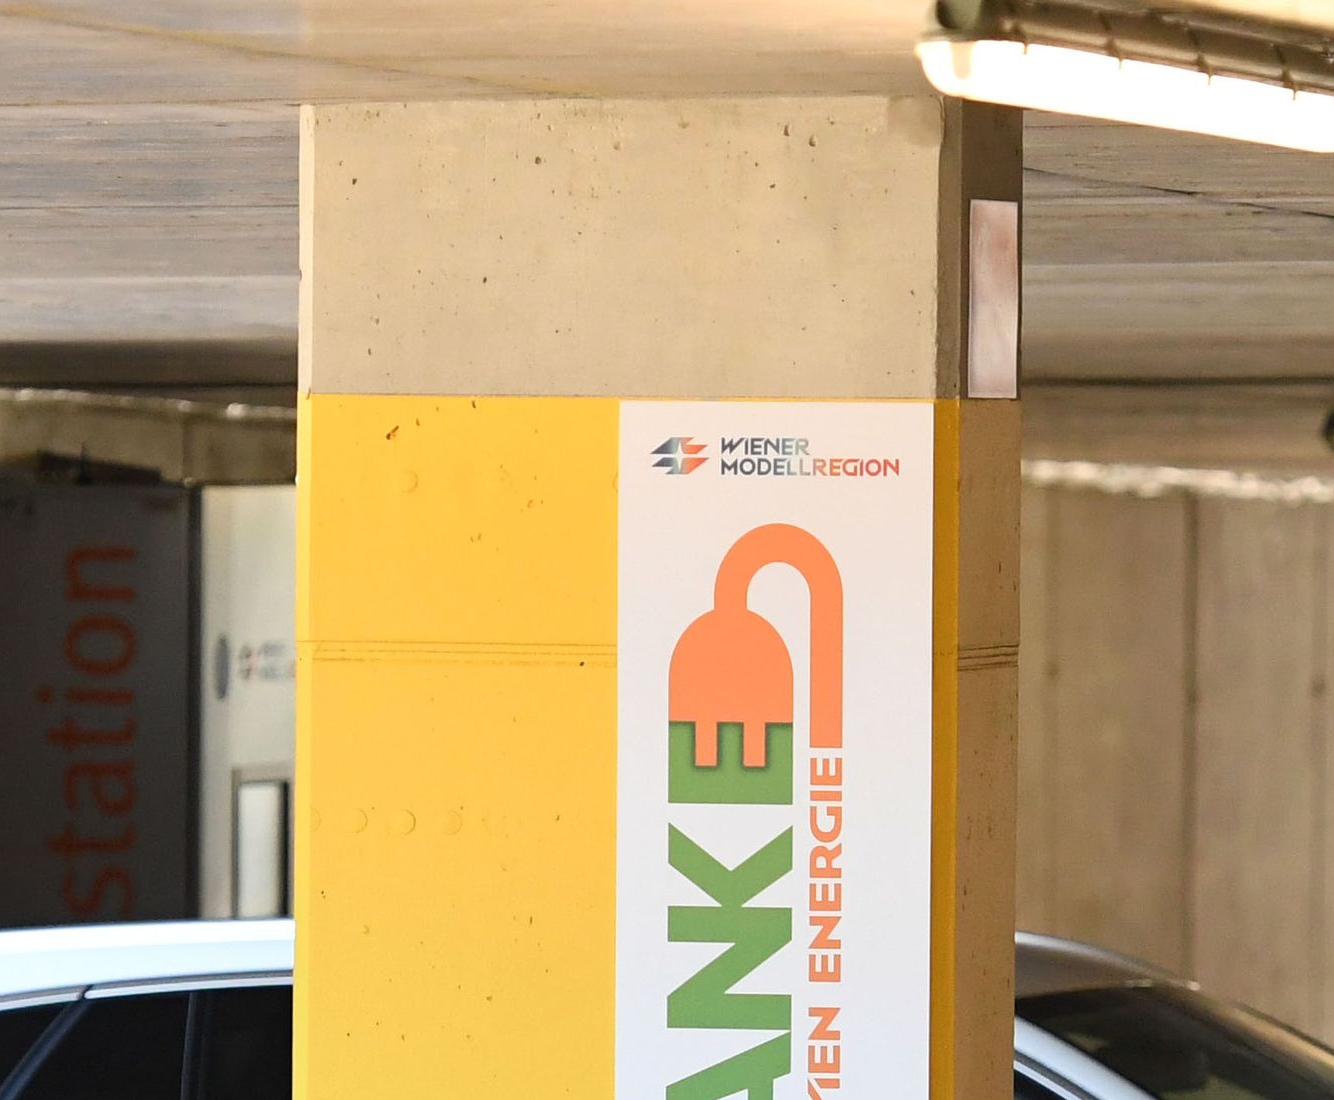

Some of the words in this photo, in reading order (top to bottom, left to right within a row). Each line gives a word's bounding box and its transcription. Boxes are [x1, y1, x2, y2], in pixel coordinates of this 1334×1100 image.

[721, 437, 809, 456] WIENER
[721, 458, 900, 477] MODELLREGION
[807, 757, 843, 983] ENERGIE
